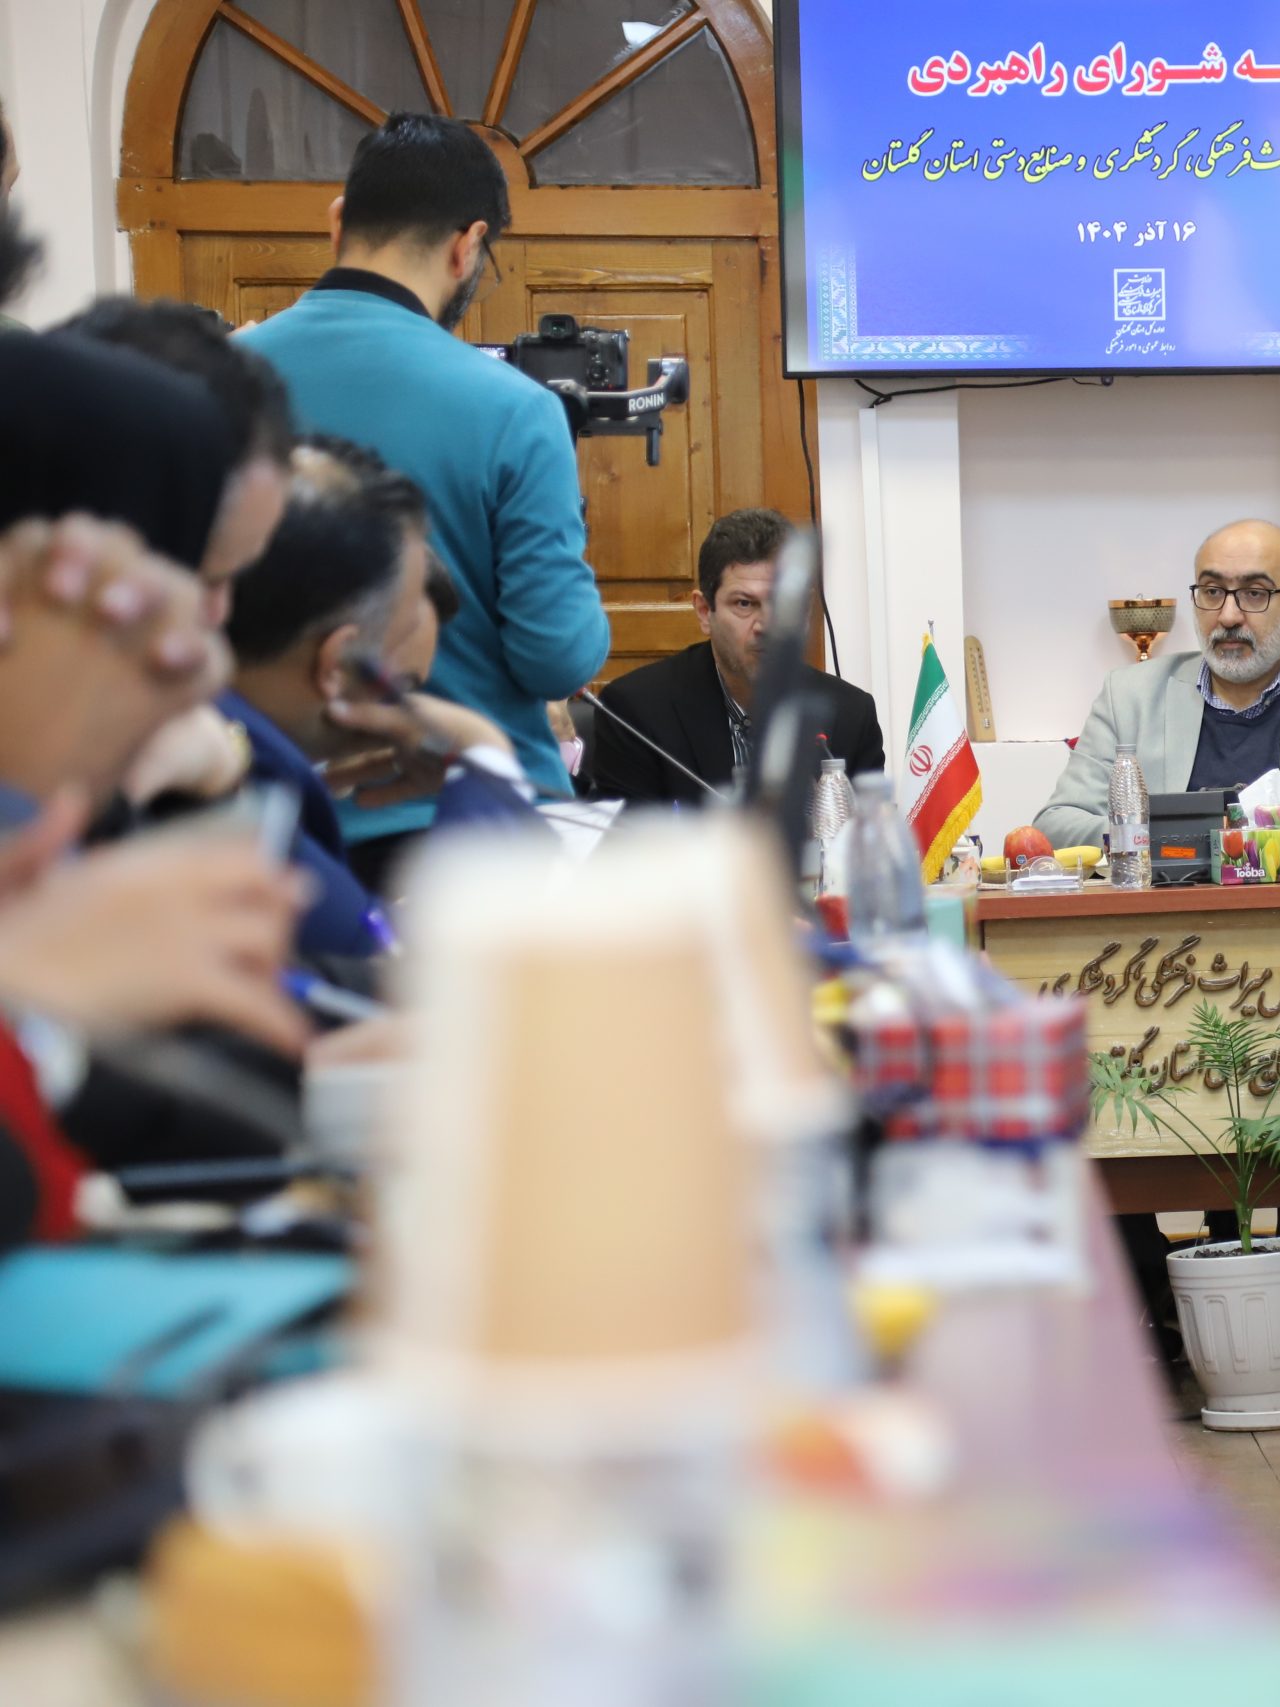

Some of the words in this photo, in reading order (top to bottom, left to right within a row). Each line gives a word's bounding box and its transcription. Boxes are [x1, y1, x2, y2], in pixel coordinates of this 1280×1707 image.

[907, 41, 1067, 97] راهبردی
[1074, 41, 1227, 97] شورای
[861, 127, 934, 182] گلستان
[923, 139, 979, 182] استان
[1075, 155, 1087, 172] و
[1093, 120, 1200, 180] گردشگری
[1077, 221, 1128, 243] ۱۴۰۴
[1133, 220, 1168, 247] آذر
[1172, 221, 1197, 242] ۱۶
[628, 392, 664, 413] RONIN
[1234, 867, 1265, 878] Tooba
[1197, 952, 1273, 1017] میراث
